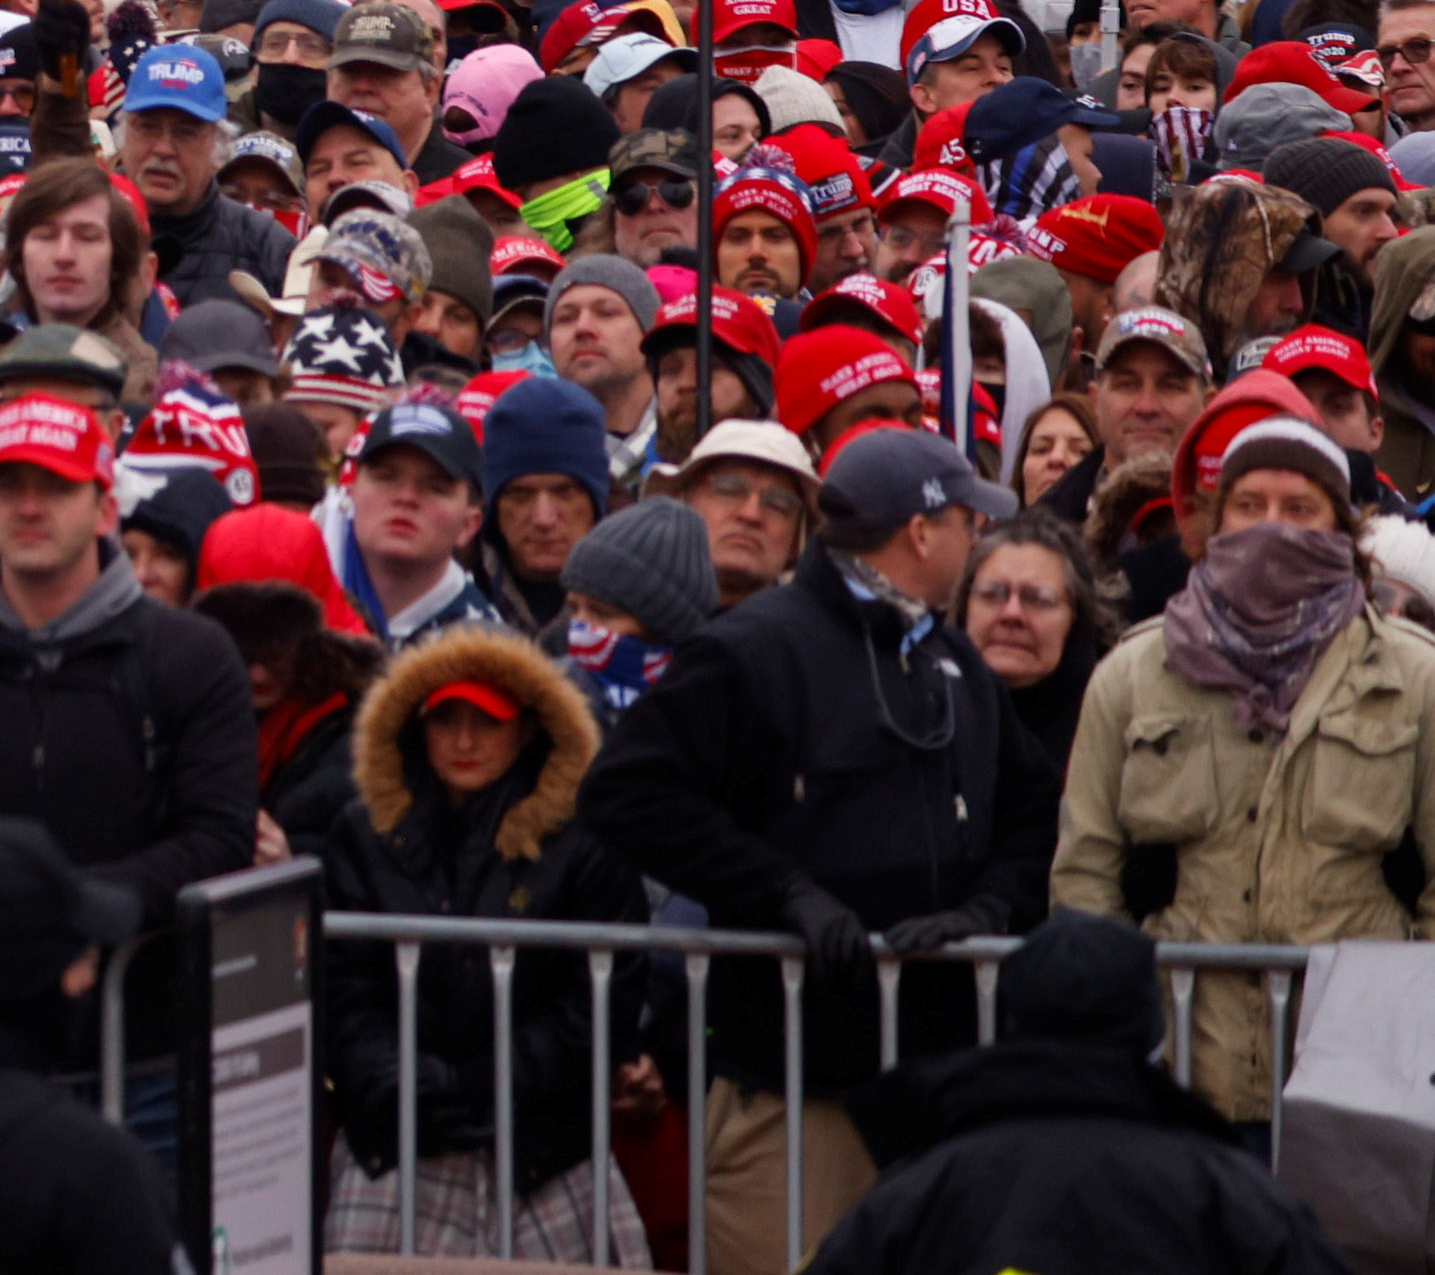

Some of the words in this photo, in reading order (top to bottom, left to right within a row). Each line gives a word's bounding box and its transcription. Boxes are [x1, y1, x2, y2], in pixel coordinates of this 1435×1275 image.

[732, 3, 773, 16] GREAT
[148, 63, 205, 85] TRUMP
[940, 139, 966, 165] 45
[1299, 336, 1351, 355] AMERICA
[21, 401, 89, 433] AMERICA
[33, 424, 77, 452] AGAIN
